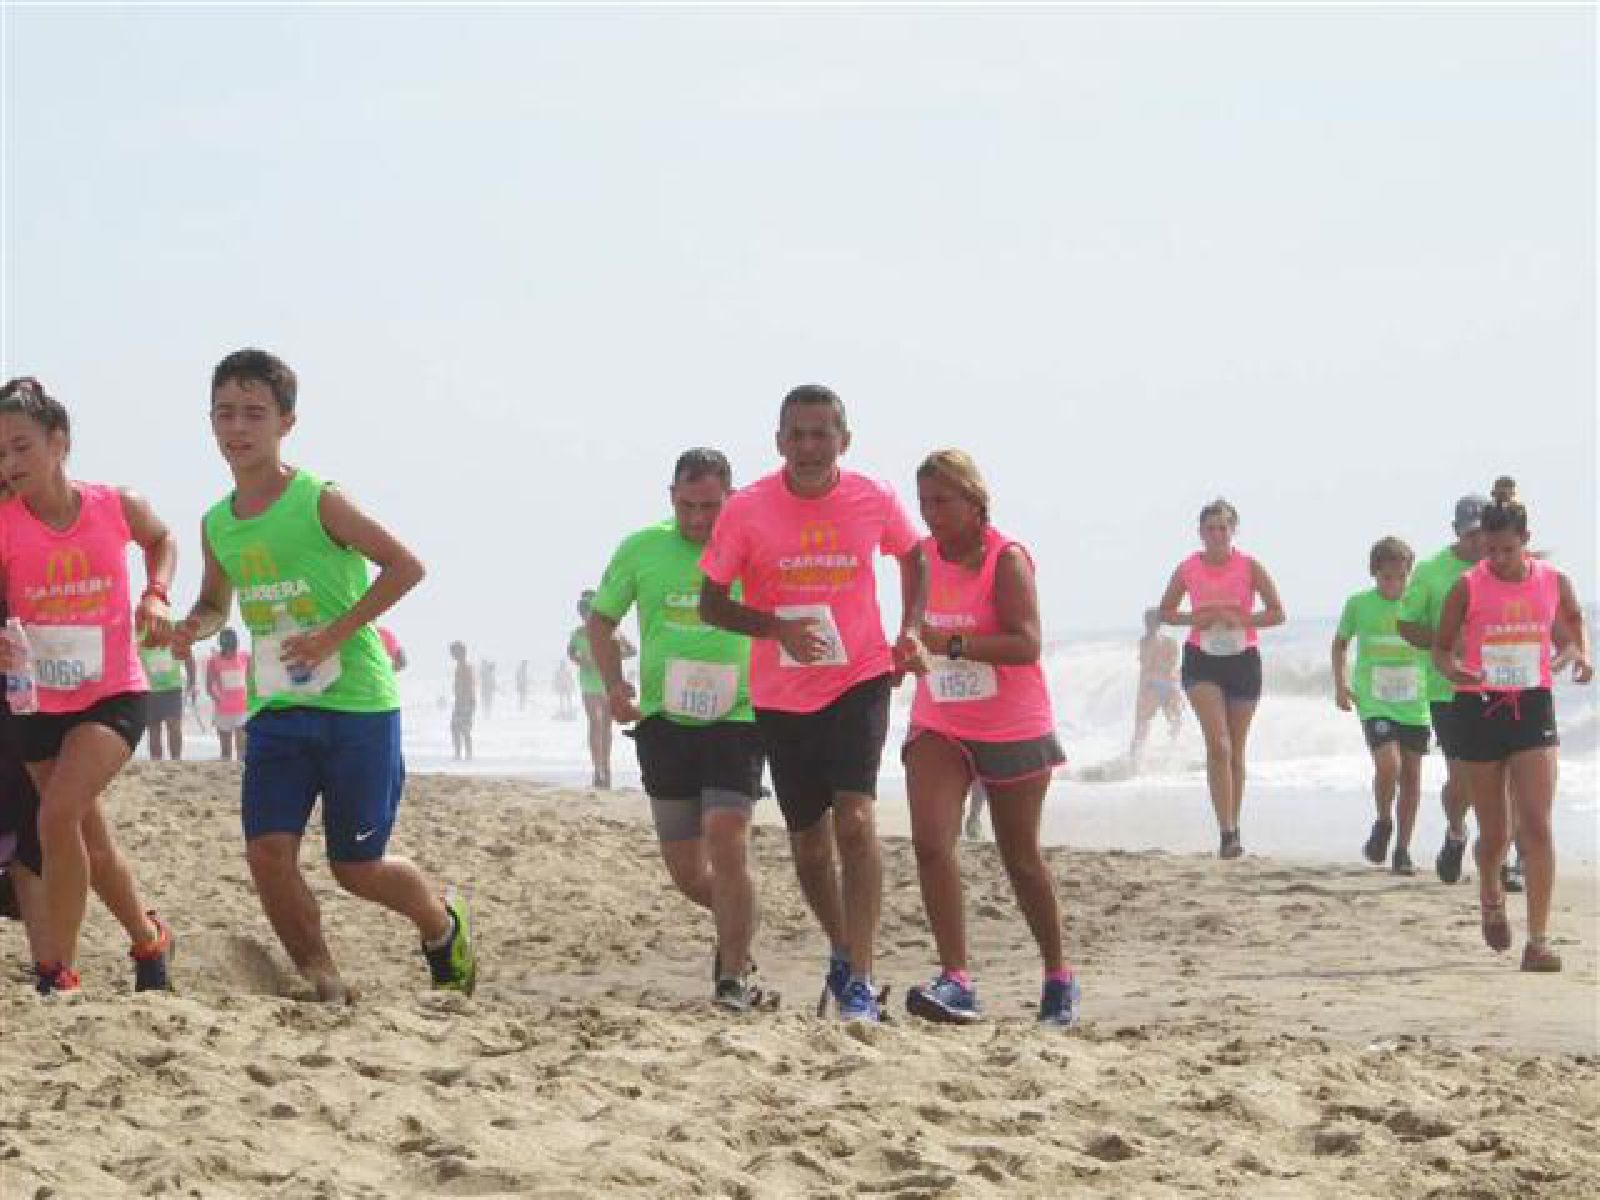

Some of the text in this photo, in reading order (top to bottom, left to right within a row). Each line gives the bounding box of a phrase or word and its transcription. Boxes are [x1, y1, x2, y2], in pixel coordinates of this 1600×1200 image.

[778, 555, 858, 570] CARRERA
[939, 671, 981, 698] 1152
[681, 690, 719, 716] 1181
